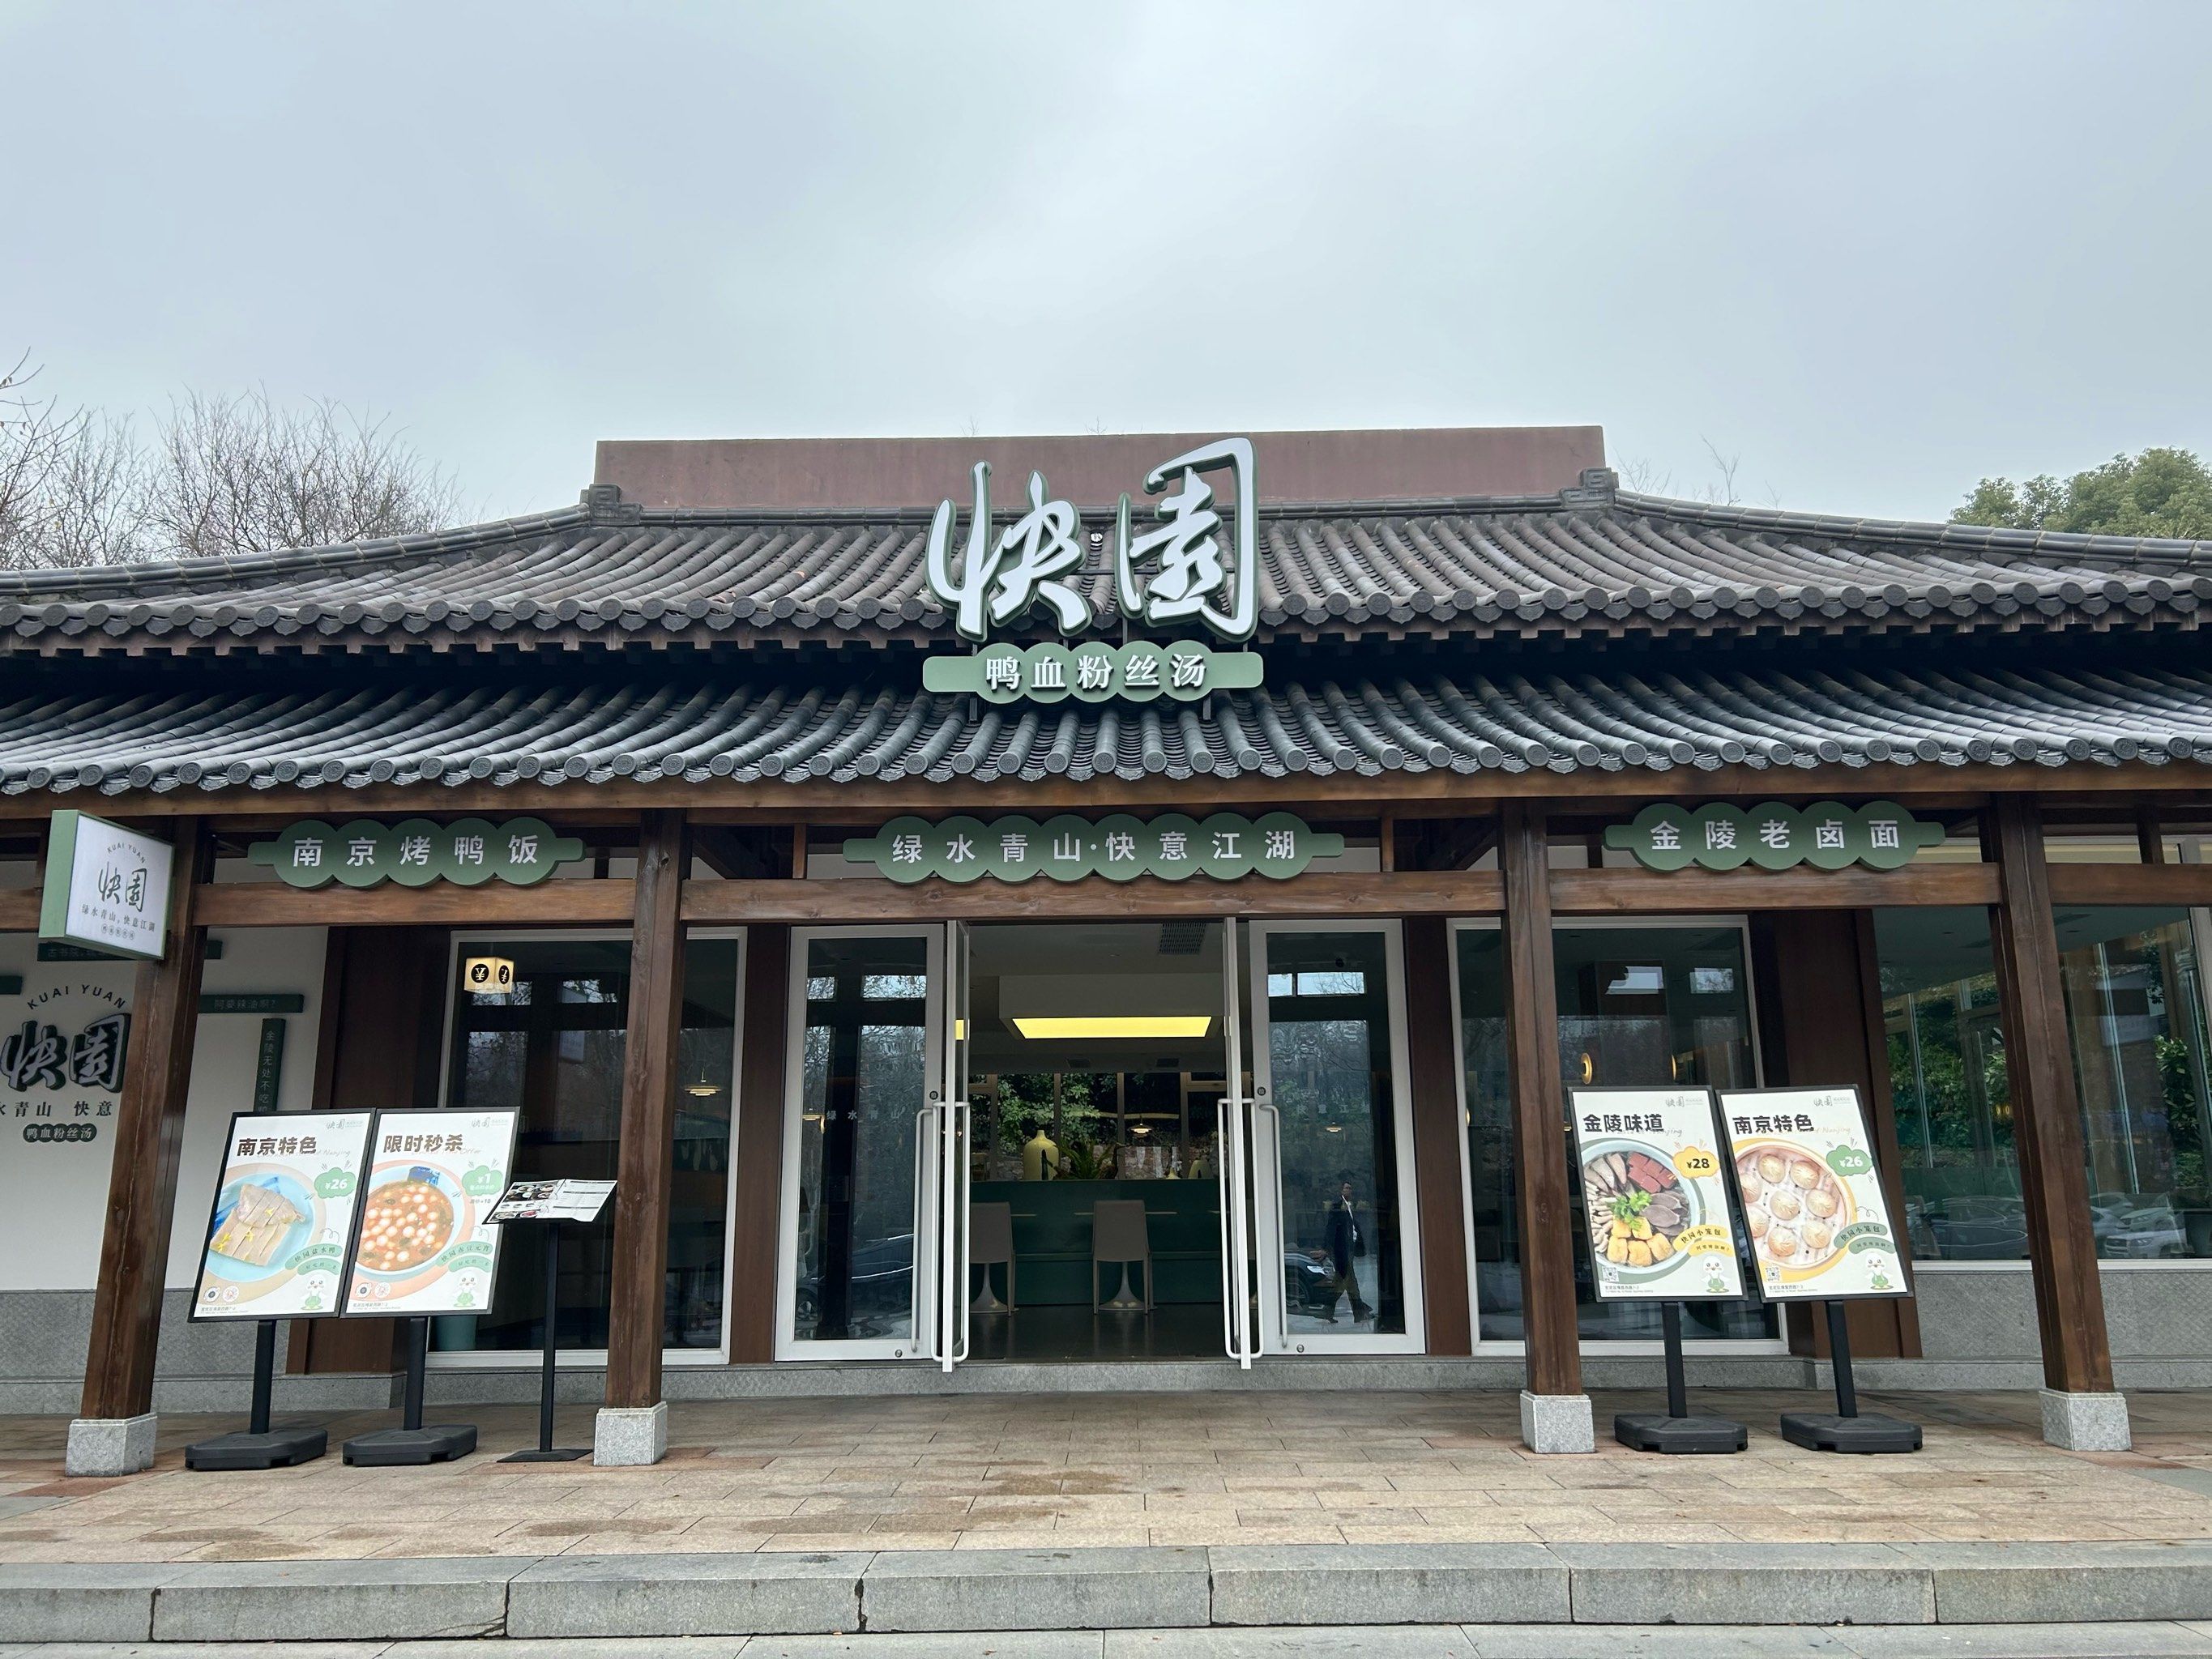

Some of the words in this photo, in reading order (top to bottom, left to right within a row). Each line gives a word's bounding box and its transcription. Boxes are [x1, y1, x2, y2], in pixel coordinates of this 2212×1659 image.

[984, 652, 1206, 691] 鸭血粉丝汤
[1649, 819, 1900, 851] 金陵老卤面
[107, 842, 125, 854] KUAI
[127, 844, 147, 864] YUAN
[292, 834, 539, 868] 南京烤鸭饭
[28, 985, 70, 1010] KUAI
[81, 984, 126, 1009] YUAN
[26, 1126, 93, 1140] 鸭血粉丝汤
[1583, 1114, 1664, 1133] 金陵味道
[1732, 1114, 1815, 1135] 南京特色
[237, 1137, 317, 1157] 南京特色
[383, 1134, 463, 1154] 限时秒杀
[1686, 1158, 1710, 1170] ¥28
[1838, 1156, 1864, 1168] ¥26
[325, 1179, 348, 1191] ¥26
